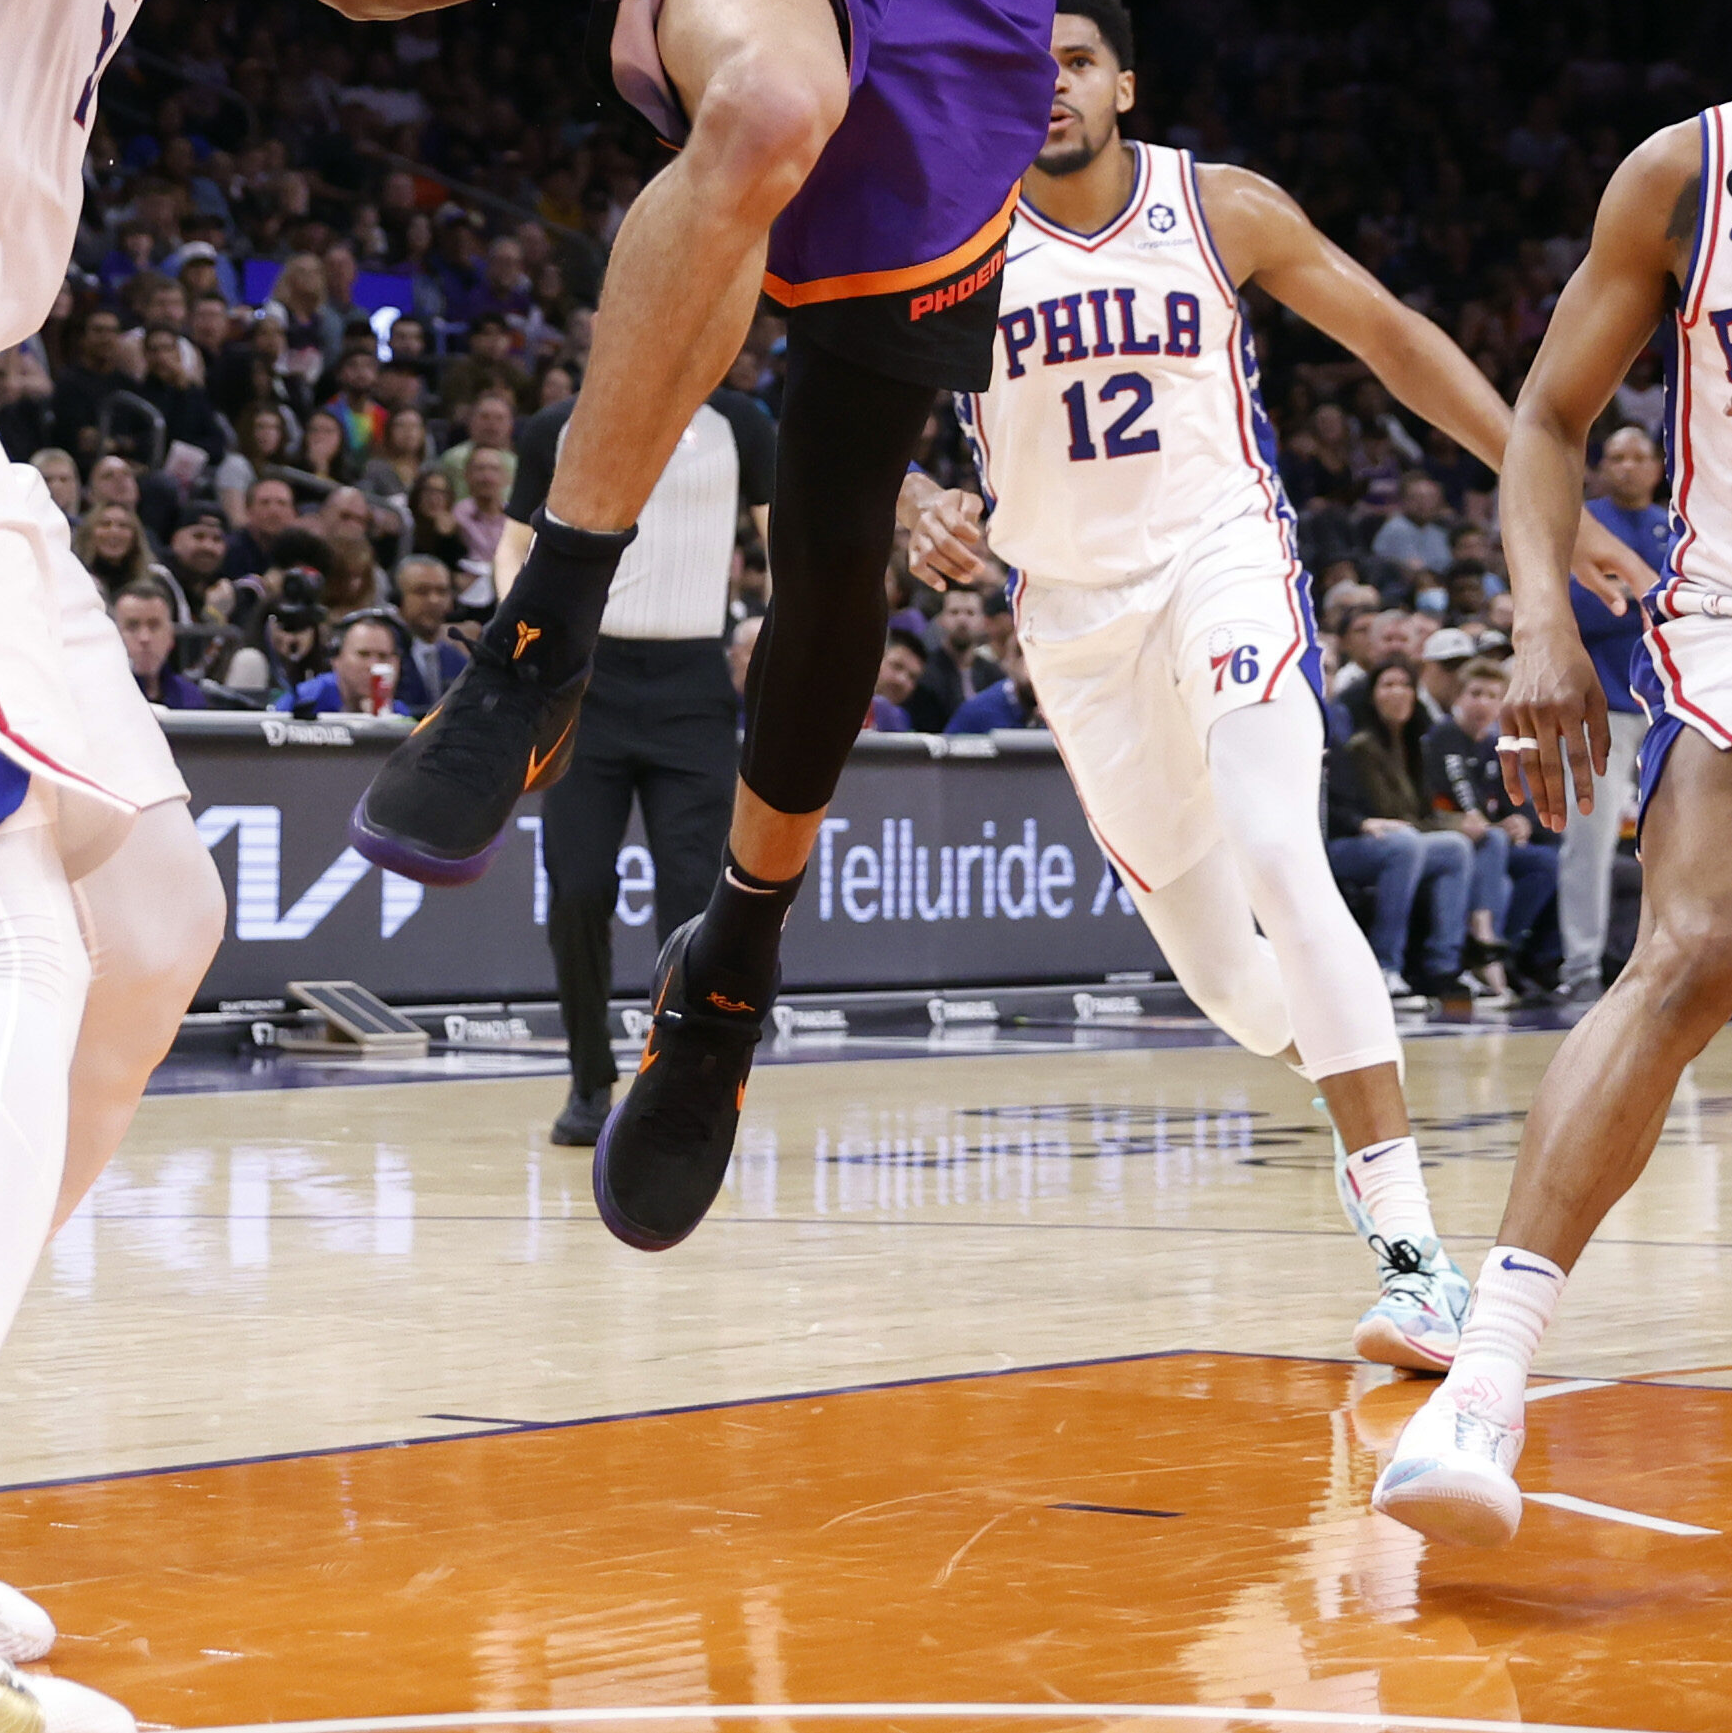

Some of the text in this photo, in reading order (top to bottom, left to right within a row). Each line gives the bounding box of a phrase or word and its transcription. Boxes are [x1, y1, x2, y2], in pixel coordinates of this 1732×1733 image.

[998, 288, 1201, 380] PHILA
[1062, 372, 1160, 461] 12
[1209, 645, 1260, 694] 76
[818, 817, 1076, 924] Telluride
